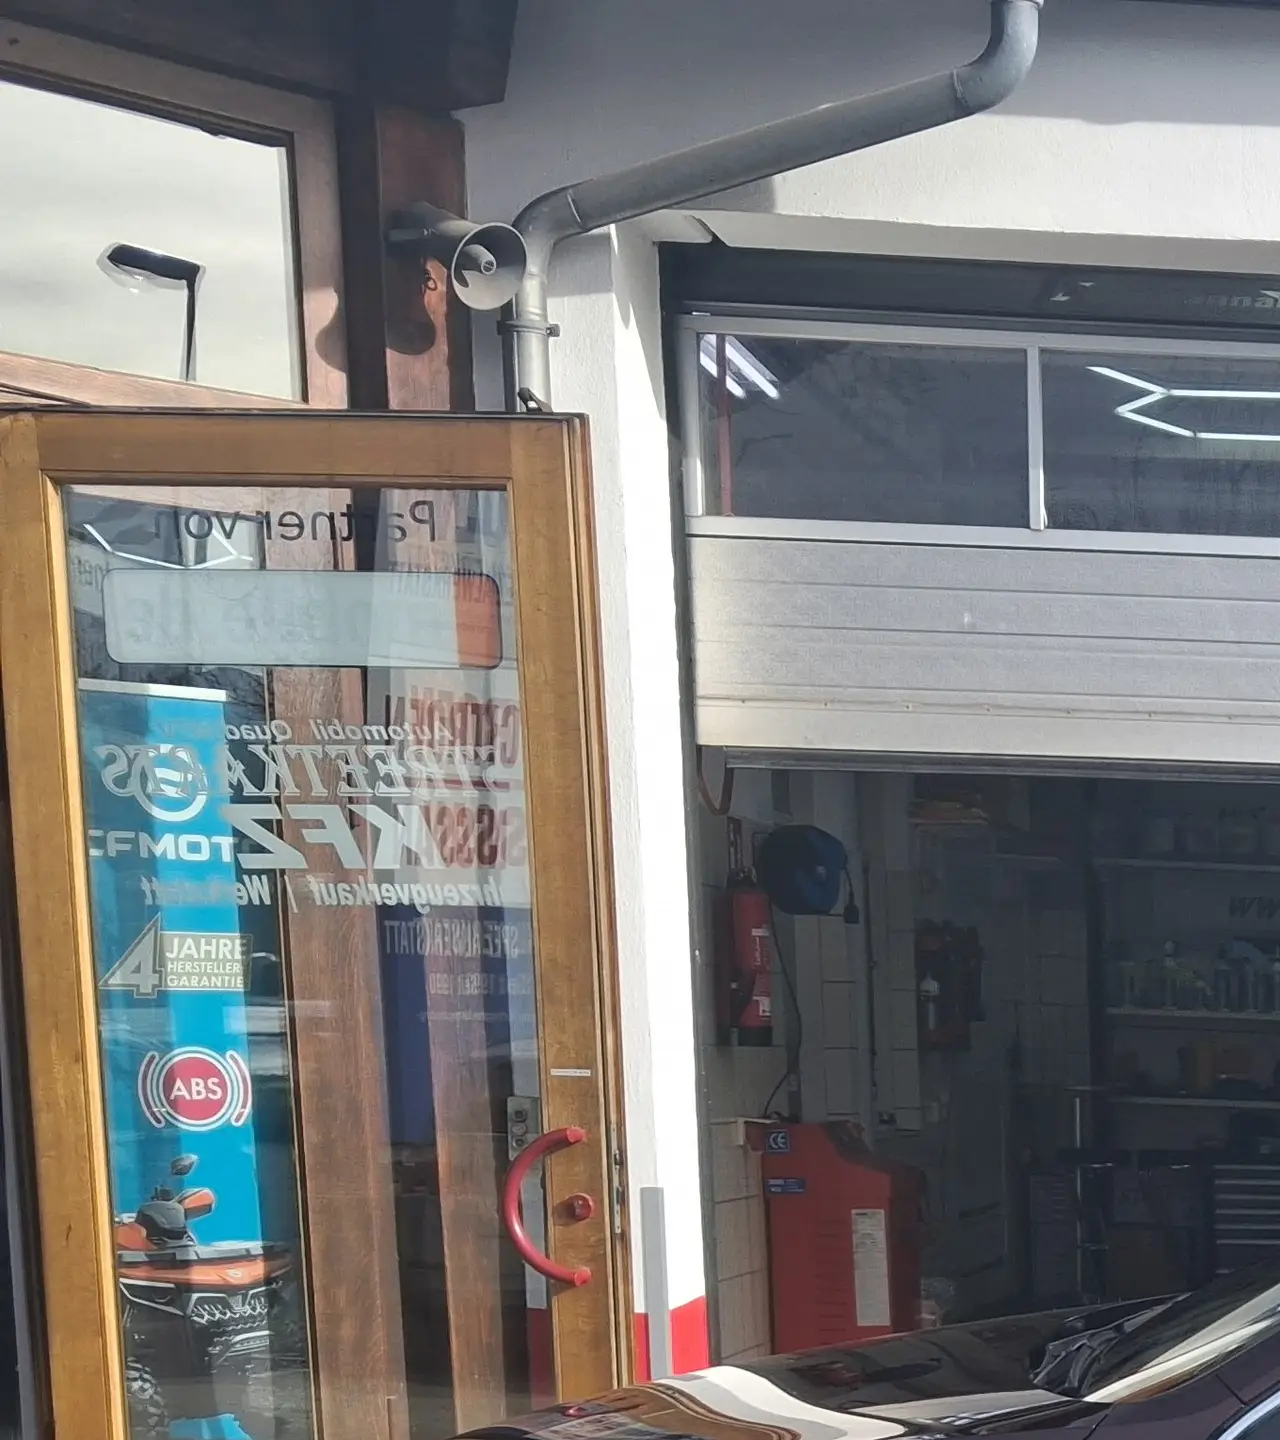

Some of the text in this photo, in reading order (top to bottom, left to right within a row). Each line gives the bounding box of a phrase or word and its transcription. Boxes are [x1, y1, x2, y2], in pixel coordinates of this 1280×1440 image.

[98, 911, 248, 999] 4 JAHRE
[166, 974, 245, 989] GARANTIE
[169, 1076, 223, 1101] ABS
